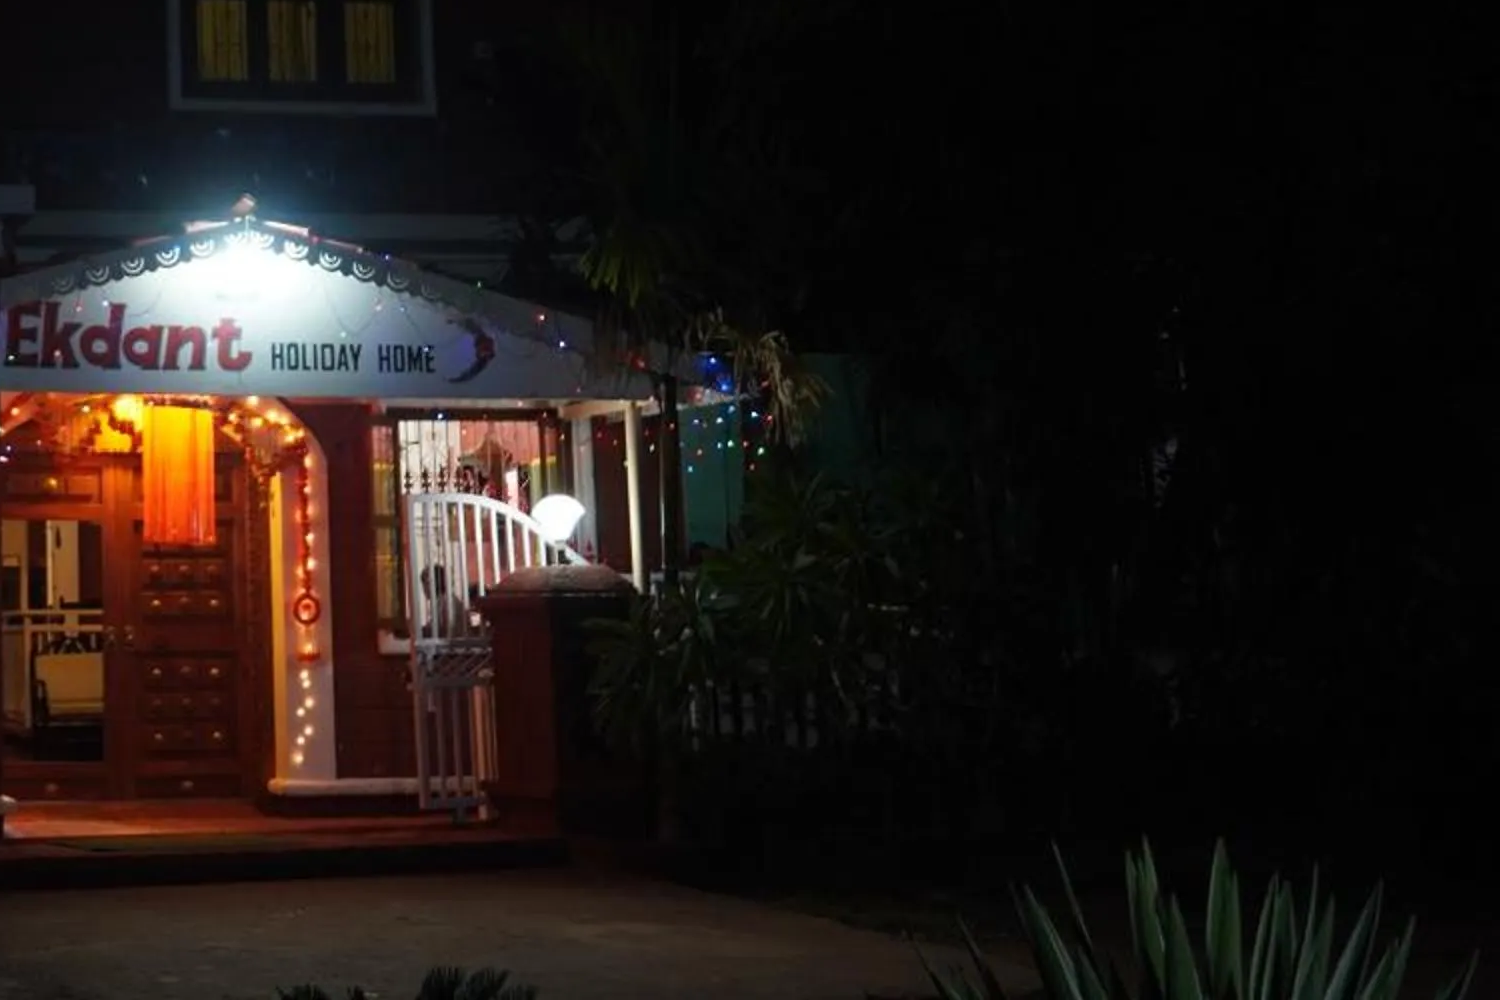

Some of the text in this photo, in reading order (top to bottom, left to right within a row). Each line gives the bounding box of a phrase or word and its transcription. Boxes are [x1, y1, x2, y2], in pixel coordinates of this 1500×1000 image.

[2, 300, 437, 374] Ekdant HOLIDAY HOME
